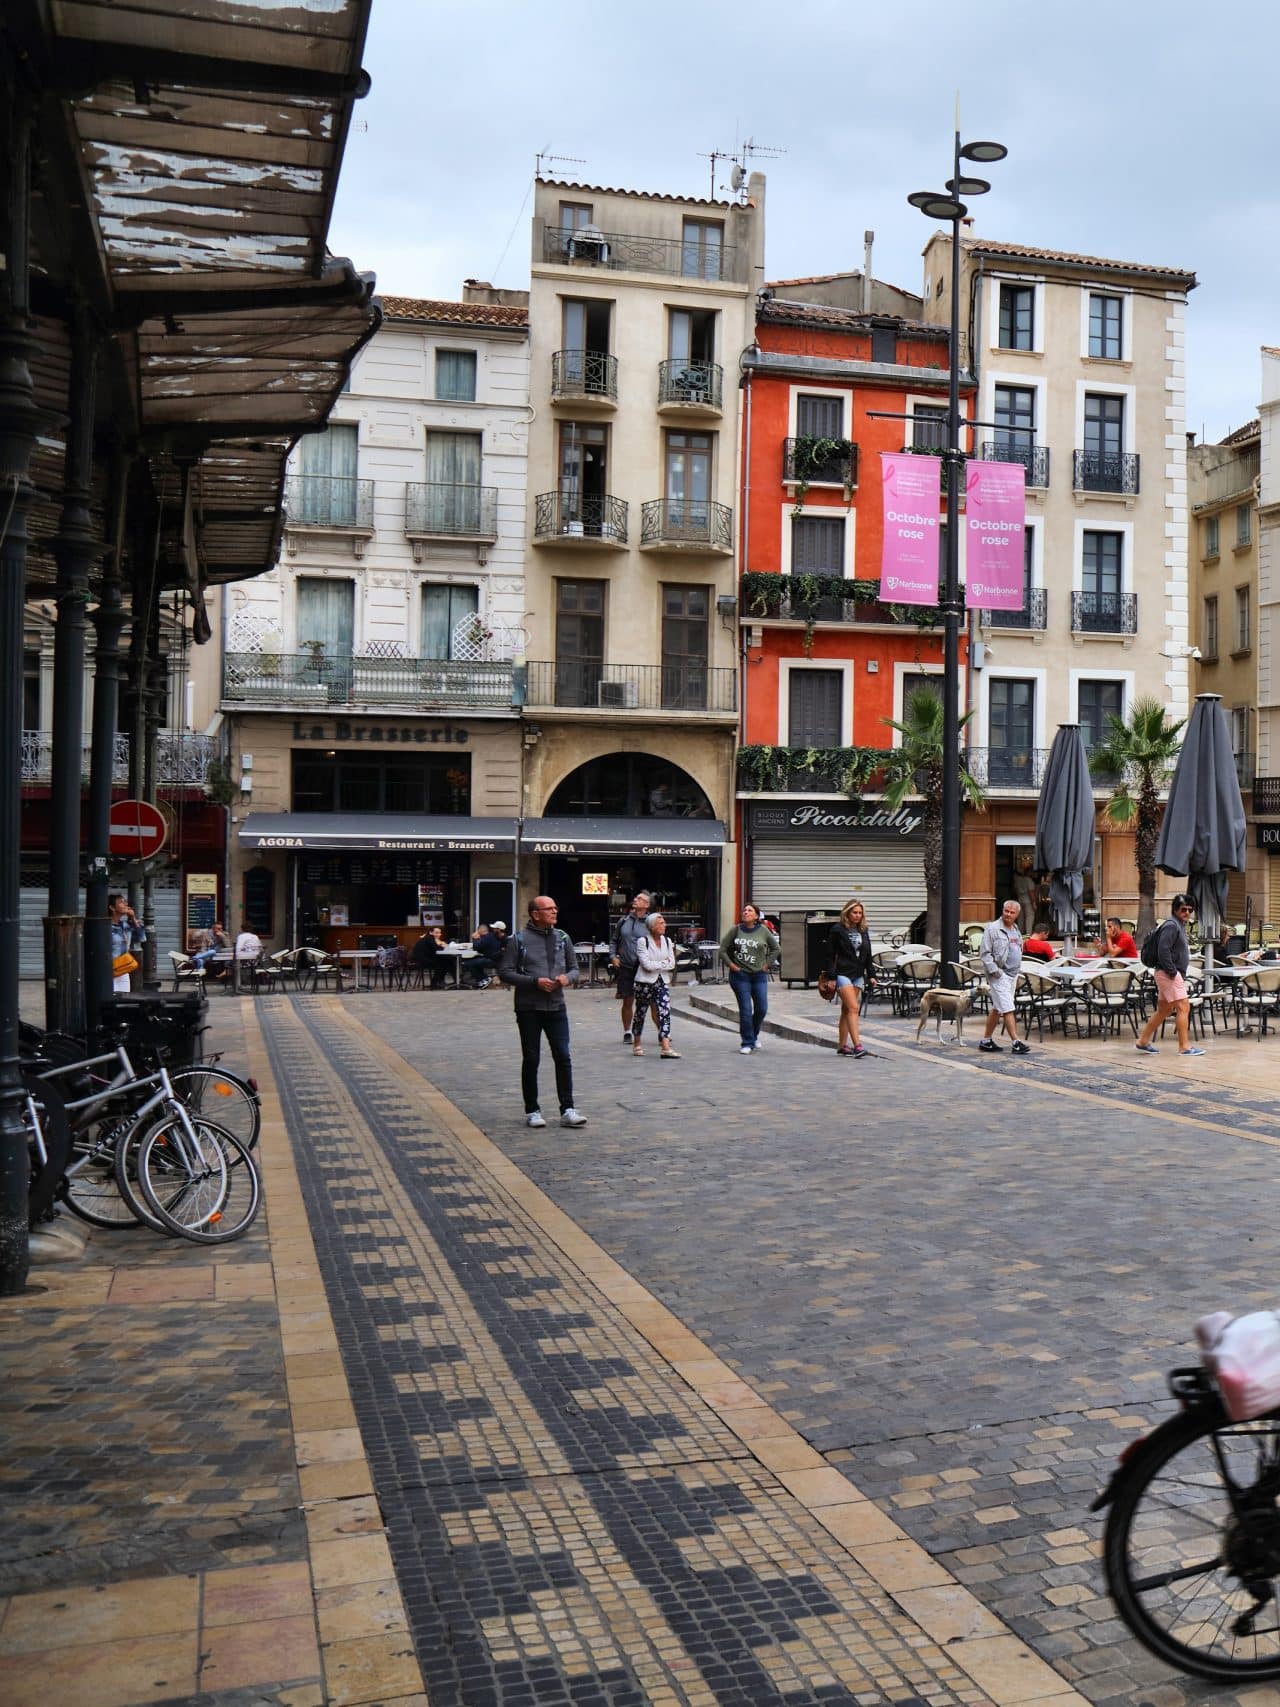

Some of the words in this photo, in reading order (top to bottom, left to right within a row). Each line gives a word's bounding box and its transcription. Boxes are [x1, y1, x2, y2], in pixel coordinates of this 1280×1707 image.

[887, 511, 936, 526] Octobre
[969, 519, 1021, 532] Octobre
[898, 528, 925, 539] rose
[981, 535, 1009, 546] rose
[899, 579, 933, 590] Narbonne
[984, 585, 1018, 595] Narbonne
[293, 721, 324, 741] La
[336, 721, 469, 744] Brasserie
[791, 805, 922, 835] Piccadilly
[257, 837, 305, 847] AGORA
[378, 840, 436, 850] Restaurant
[448, 841, 496, 850] Brasserie
[534, 843, 576, 853] AGORA
[642, 846, 672, 855] Coffee
[679, 846, 710, 857] Crêpes
[734, 938, 759, 949] ROCK
[734, 951, 757, 964] OVE
